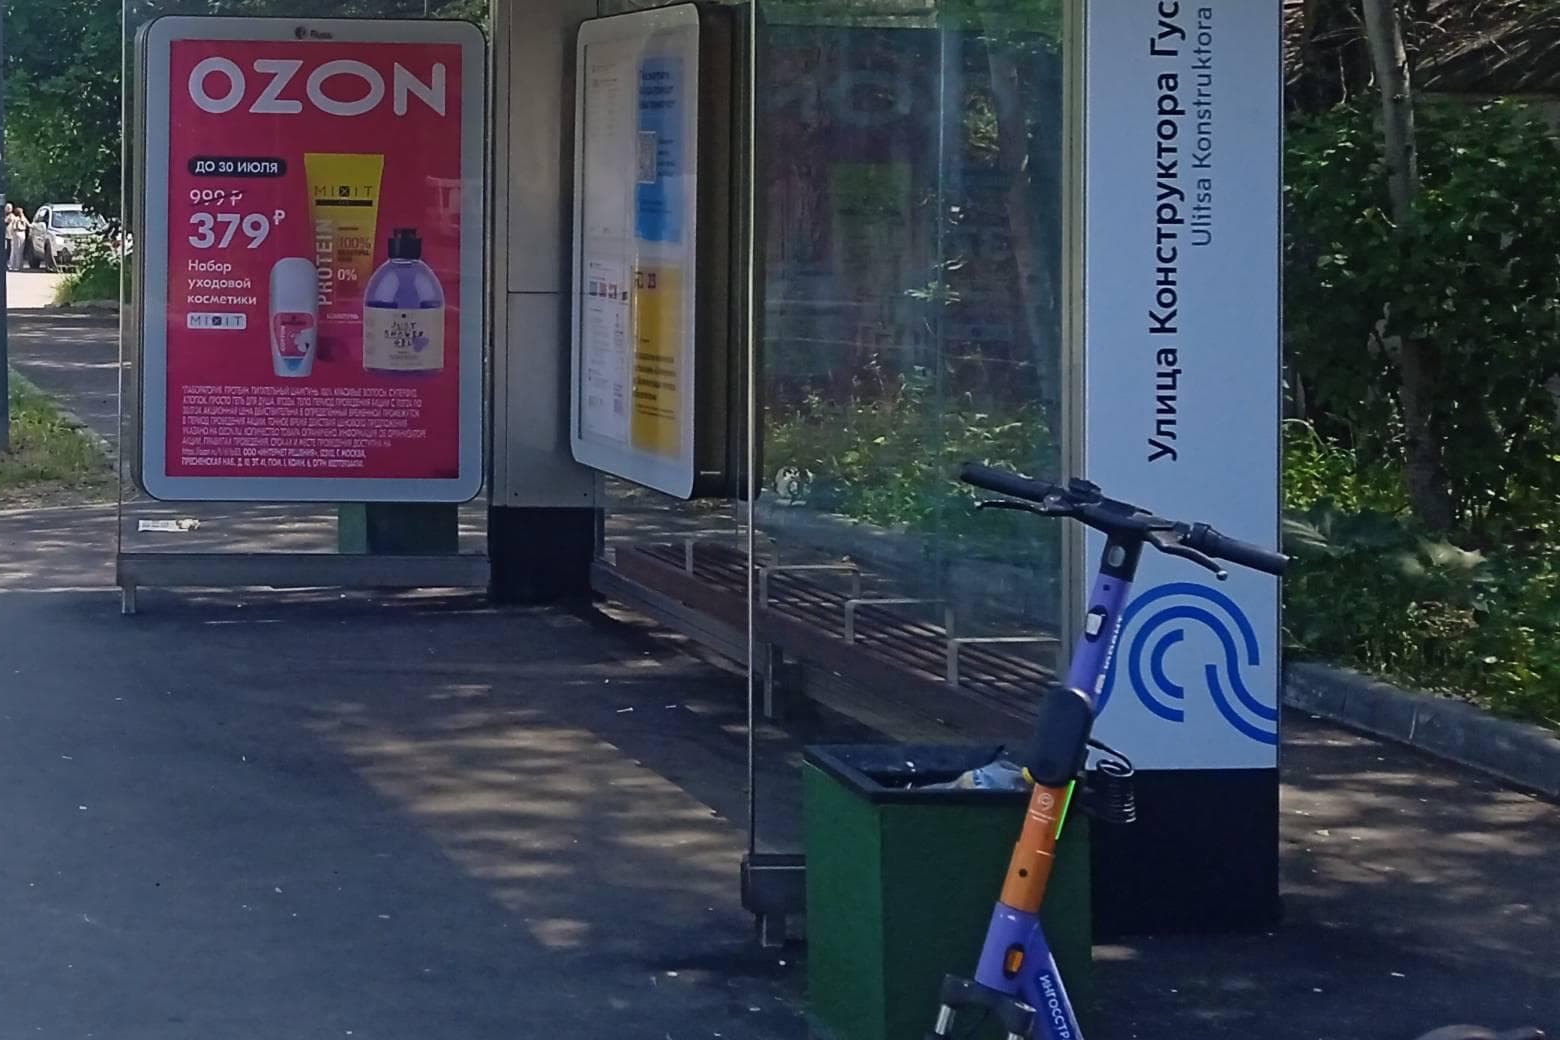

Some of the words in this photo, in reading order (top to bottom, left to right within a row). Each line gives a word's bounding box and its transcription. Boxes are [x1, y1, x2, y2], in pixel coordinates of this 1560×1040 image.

[188, 56, 446, 117] OZON
[1191, 7, 1215, 168] Konstruktora
[195, 160, 215, 174] ДО
[218, 161, 234, 173] 30
[237, 161, 278, 173] ИЮЛЯ
[1148, 72, 1186, 335] Конструктора
[1191, 178, 1212, 246] Ulitsa
[188, 259, 232, 273] Набор
[188, 277, 251, 290] уходовой
[337, 268, 358, 281] 0%
[187, 293, 257, 306] косметики
[1148, 347, 1184, 462] Улица
[1039, 974, 1071, 1040] ИНГОССТР
